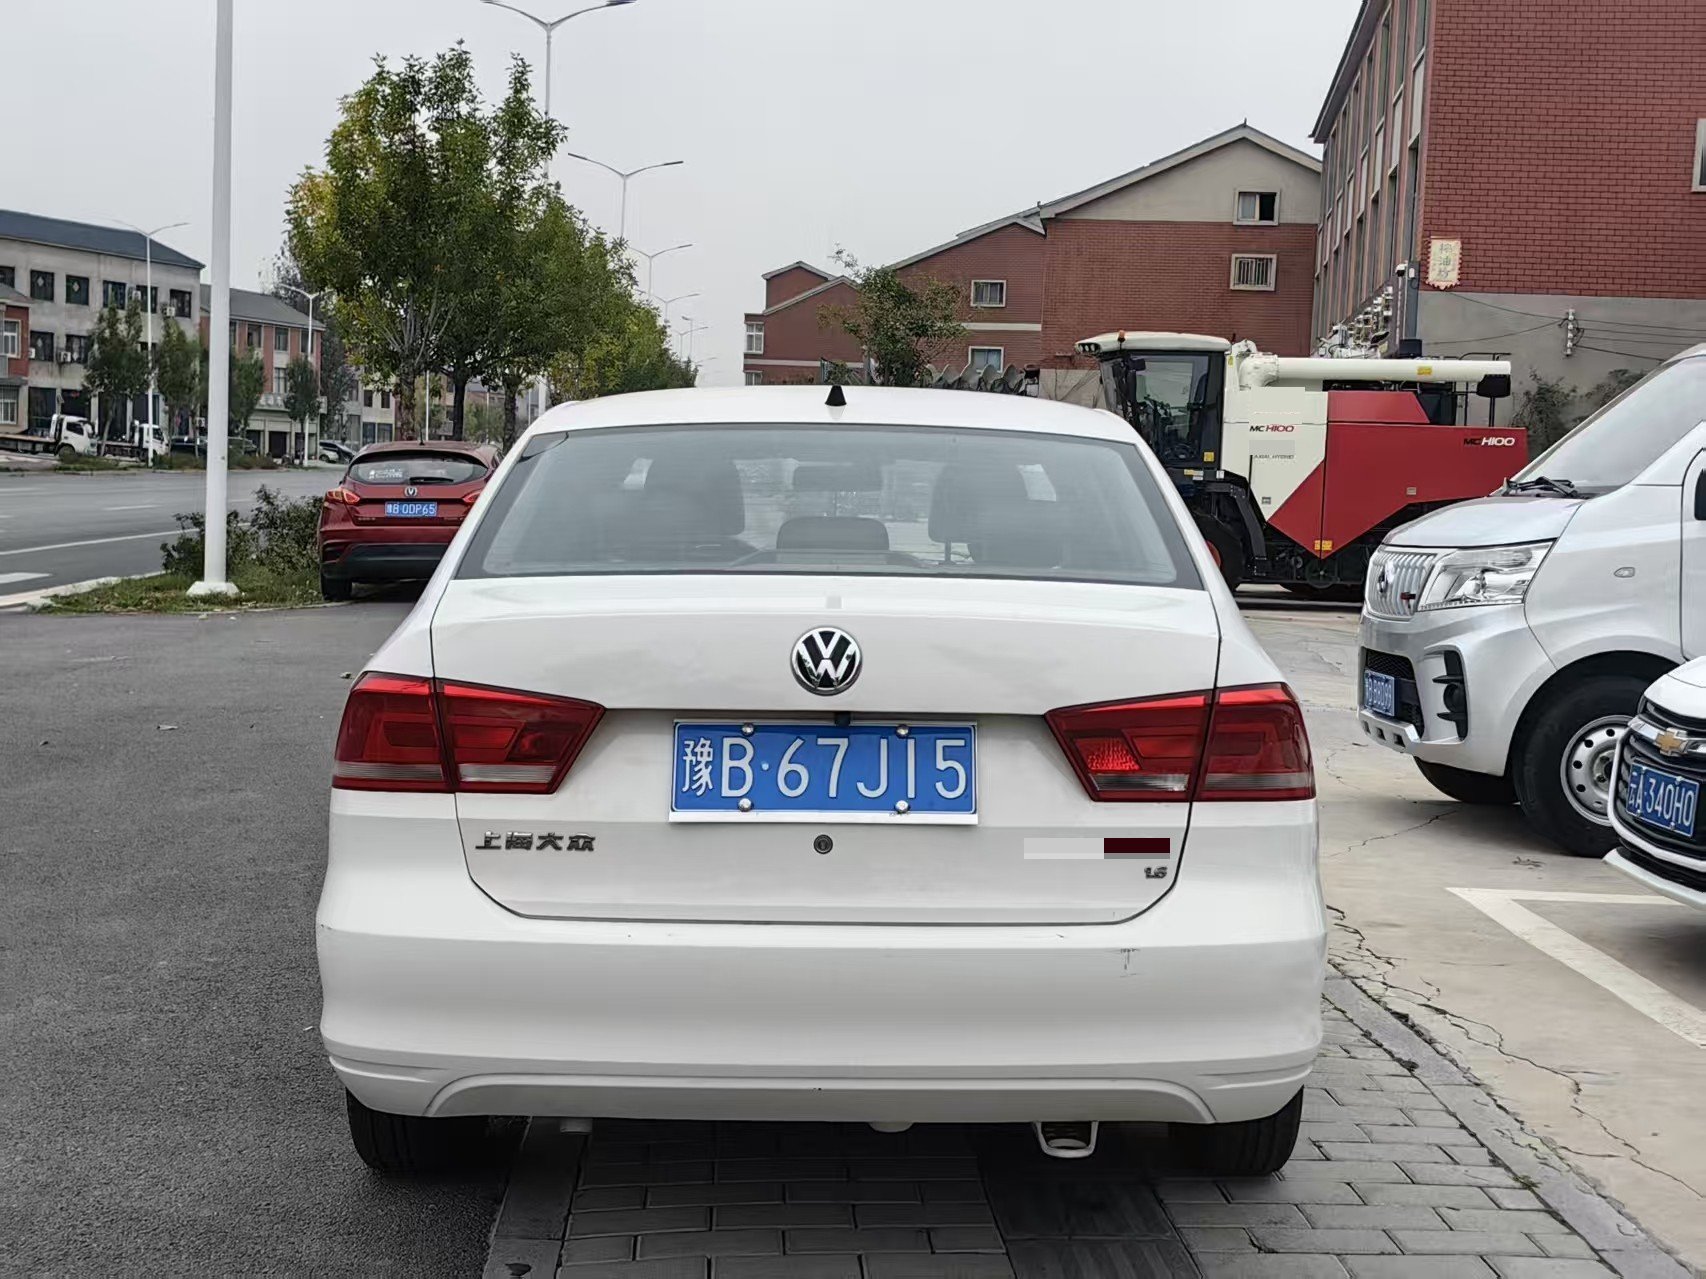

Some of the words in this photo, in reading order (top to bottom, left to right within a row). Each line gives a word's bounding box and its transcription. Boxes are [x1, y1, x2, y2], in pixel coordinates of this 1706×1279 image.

[1481, 437, 1515, 446] H100
[475, 830, 596, 851] 上海大众
